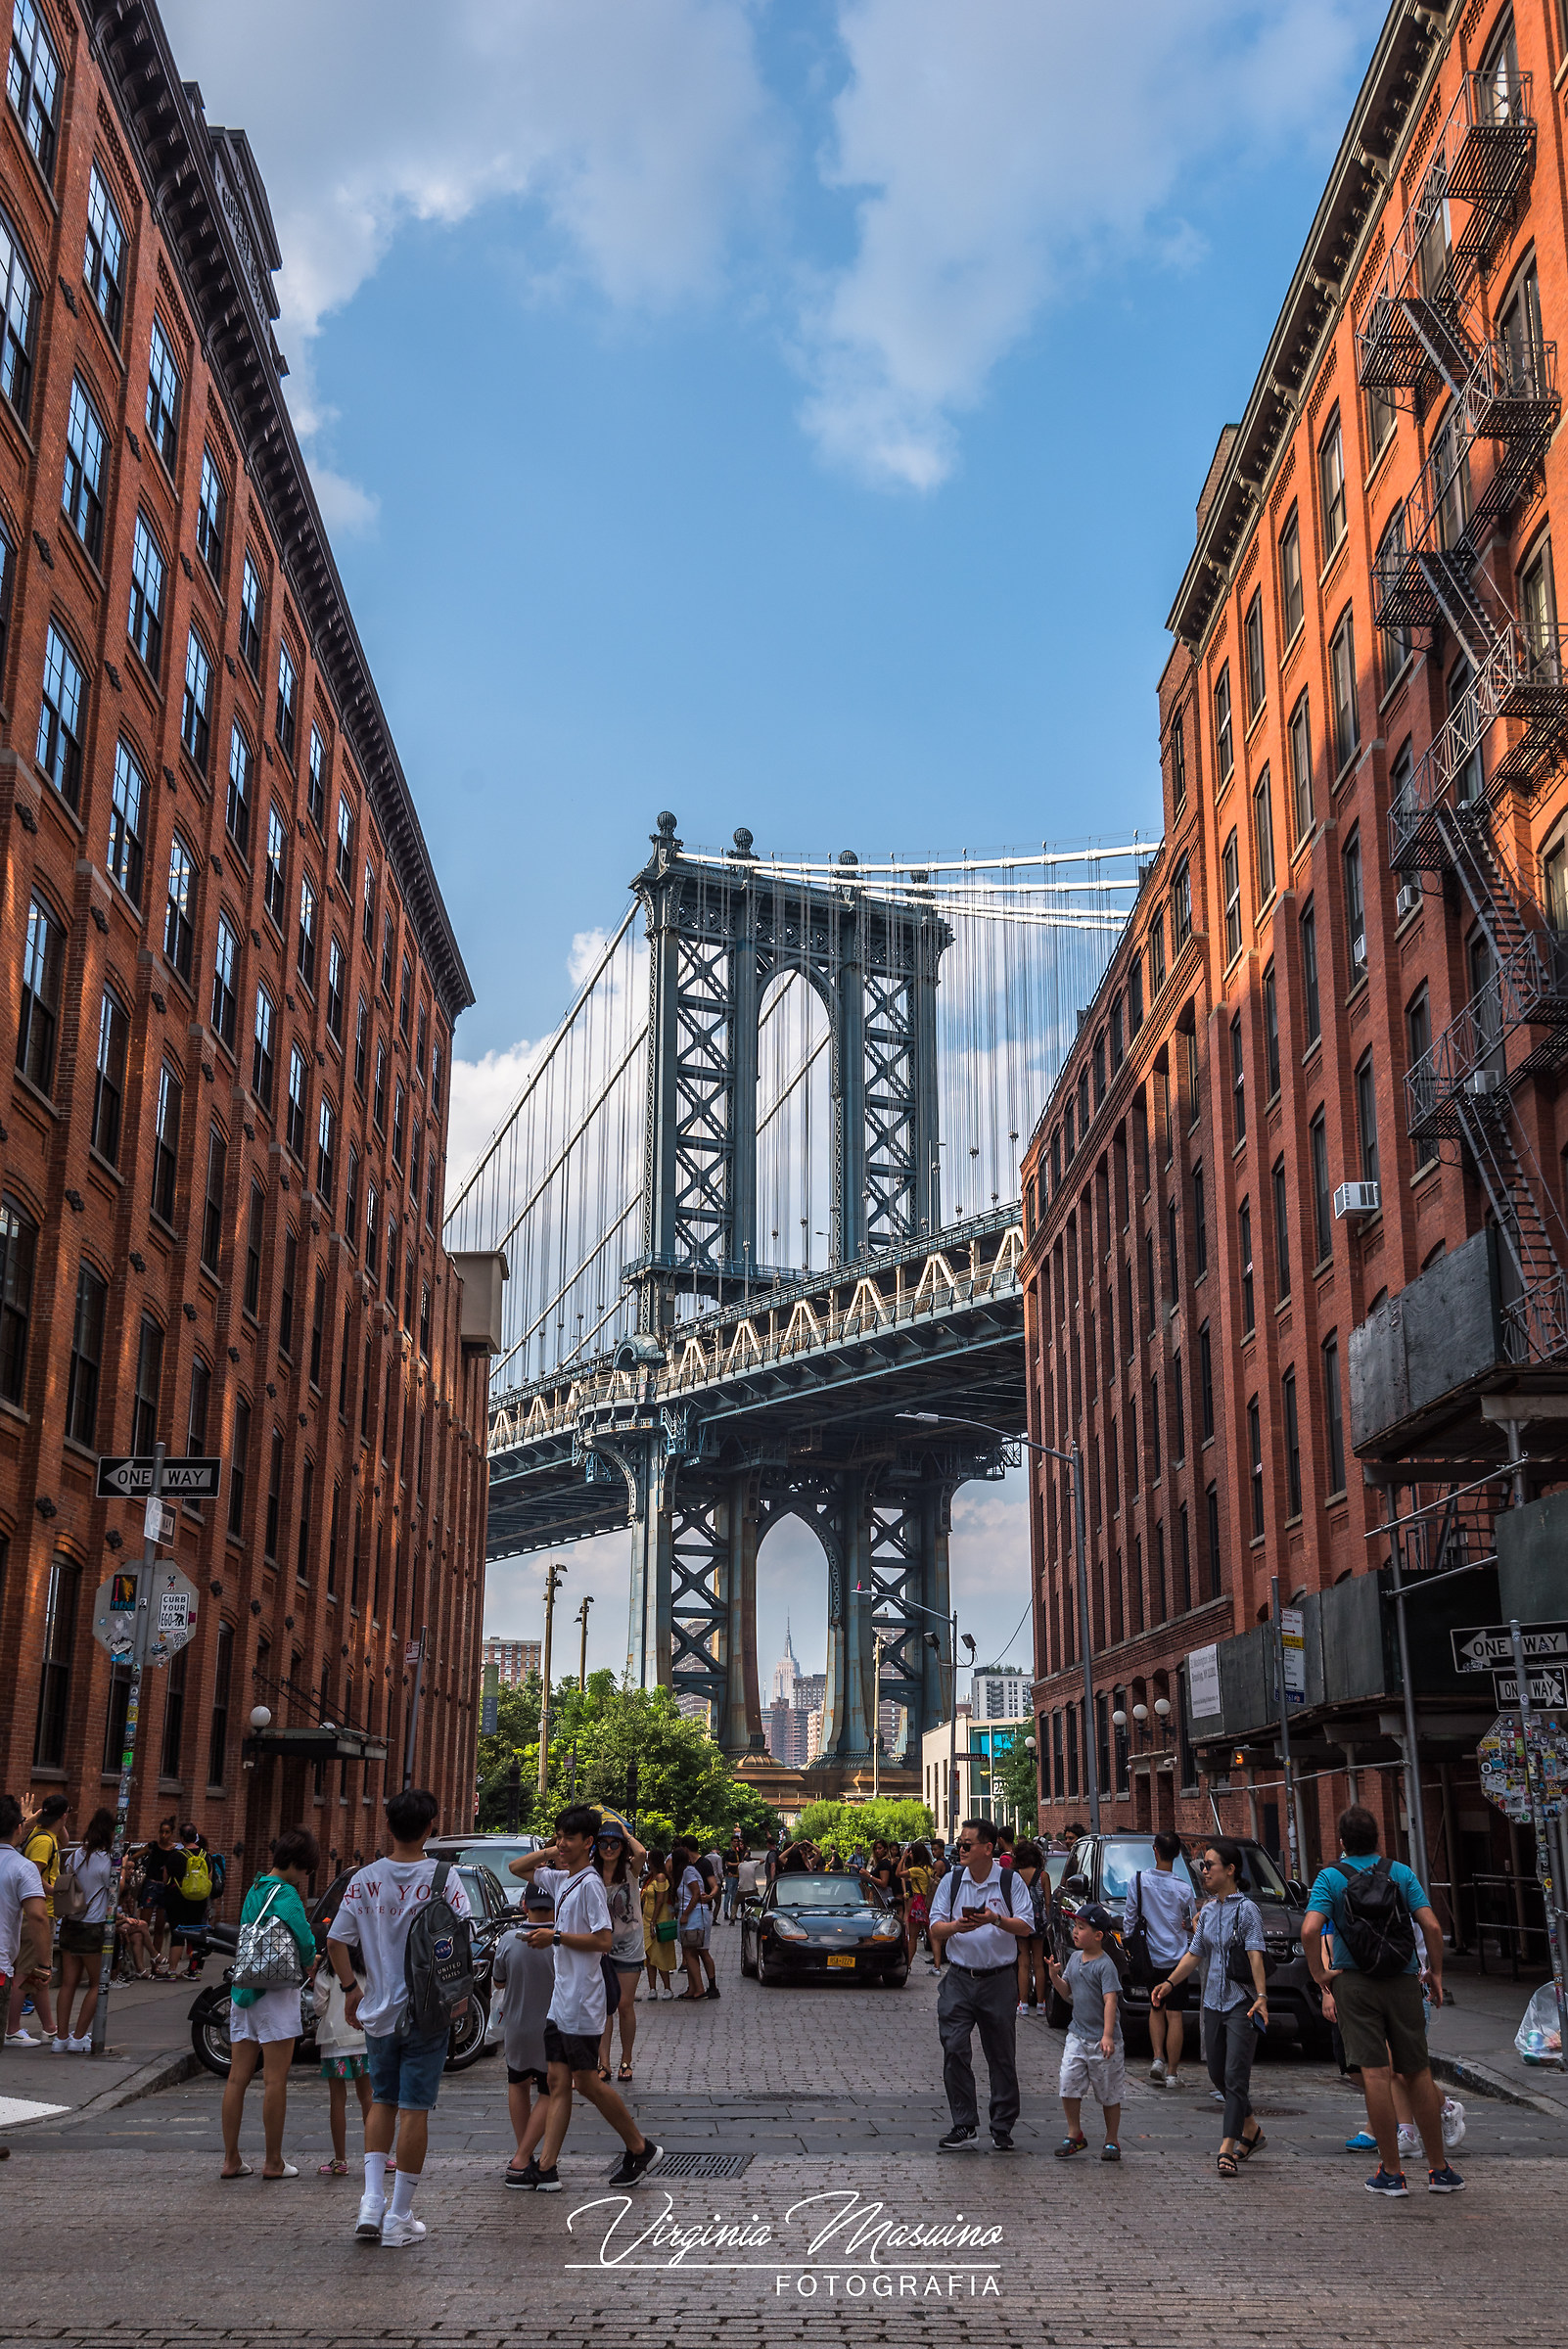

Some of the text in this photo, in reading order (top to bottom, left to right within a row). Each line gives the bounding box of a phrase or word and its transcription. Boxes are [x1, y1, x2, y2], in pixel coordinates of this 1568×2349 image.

[117, 1470, 205, 1485] ONE WAY
[161, 1612, 172, 1627] EGO
[1473, 1635, 1559, 1657] ONE WAY
[1504, 1681, 1554, 1697] ON WAY
[397, 1884, 466, 1909] YOK
[390, 1907, 404, 1915] OF
[436, 1945, 451, 1955] NASA
[437, 1961, 462, 1975] UNITED
[441, 1970, 461, 1981] STATES
